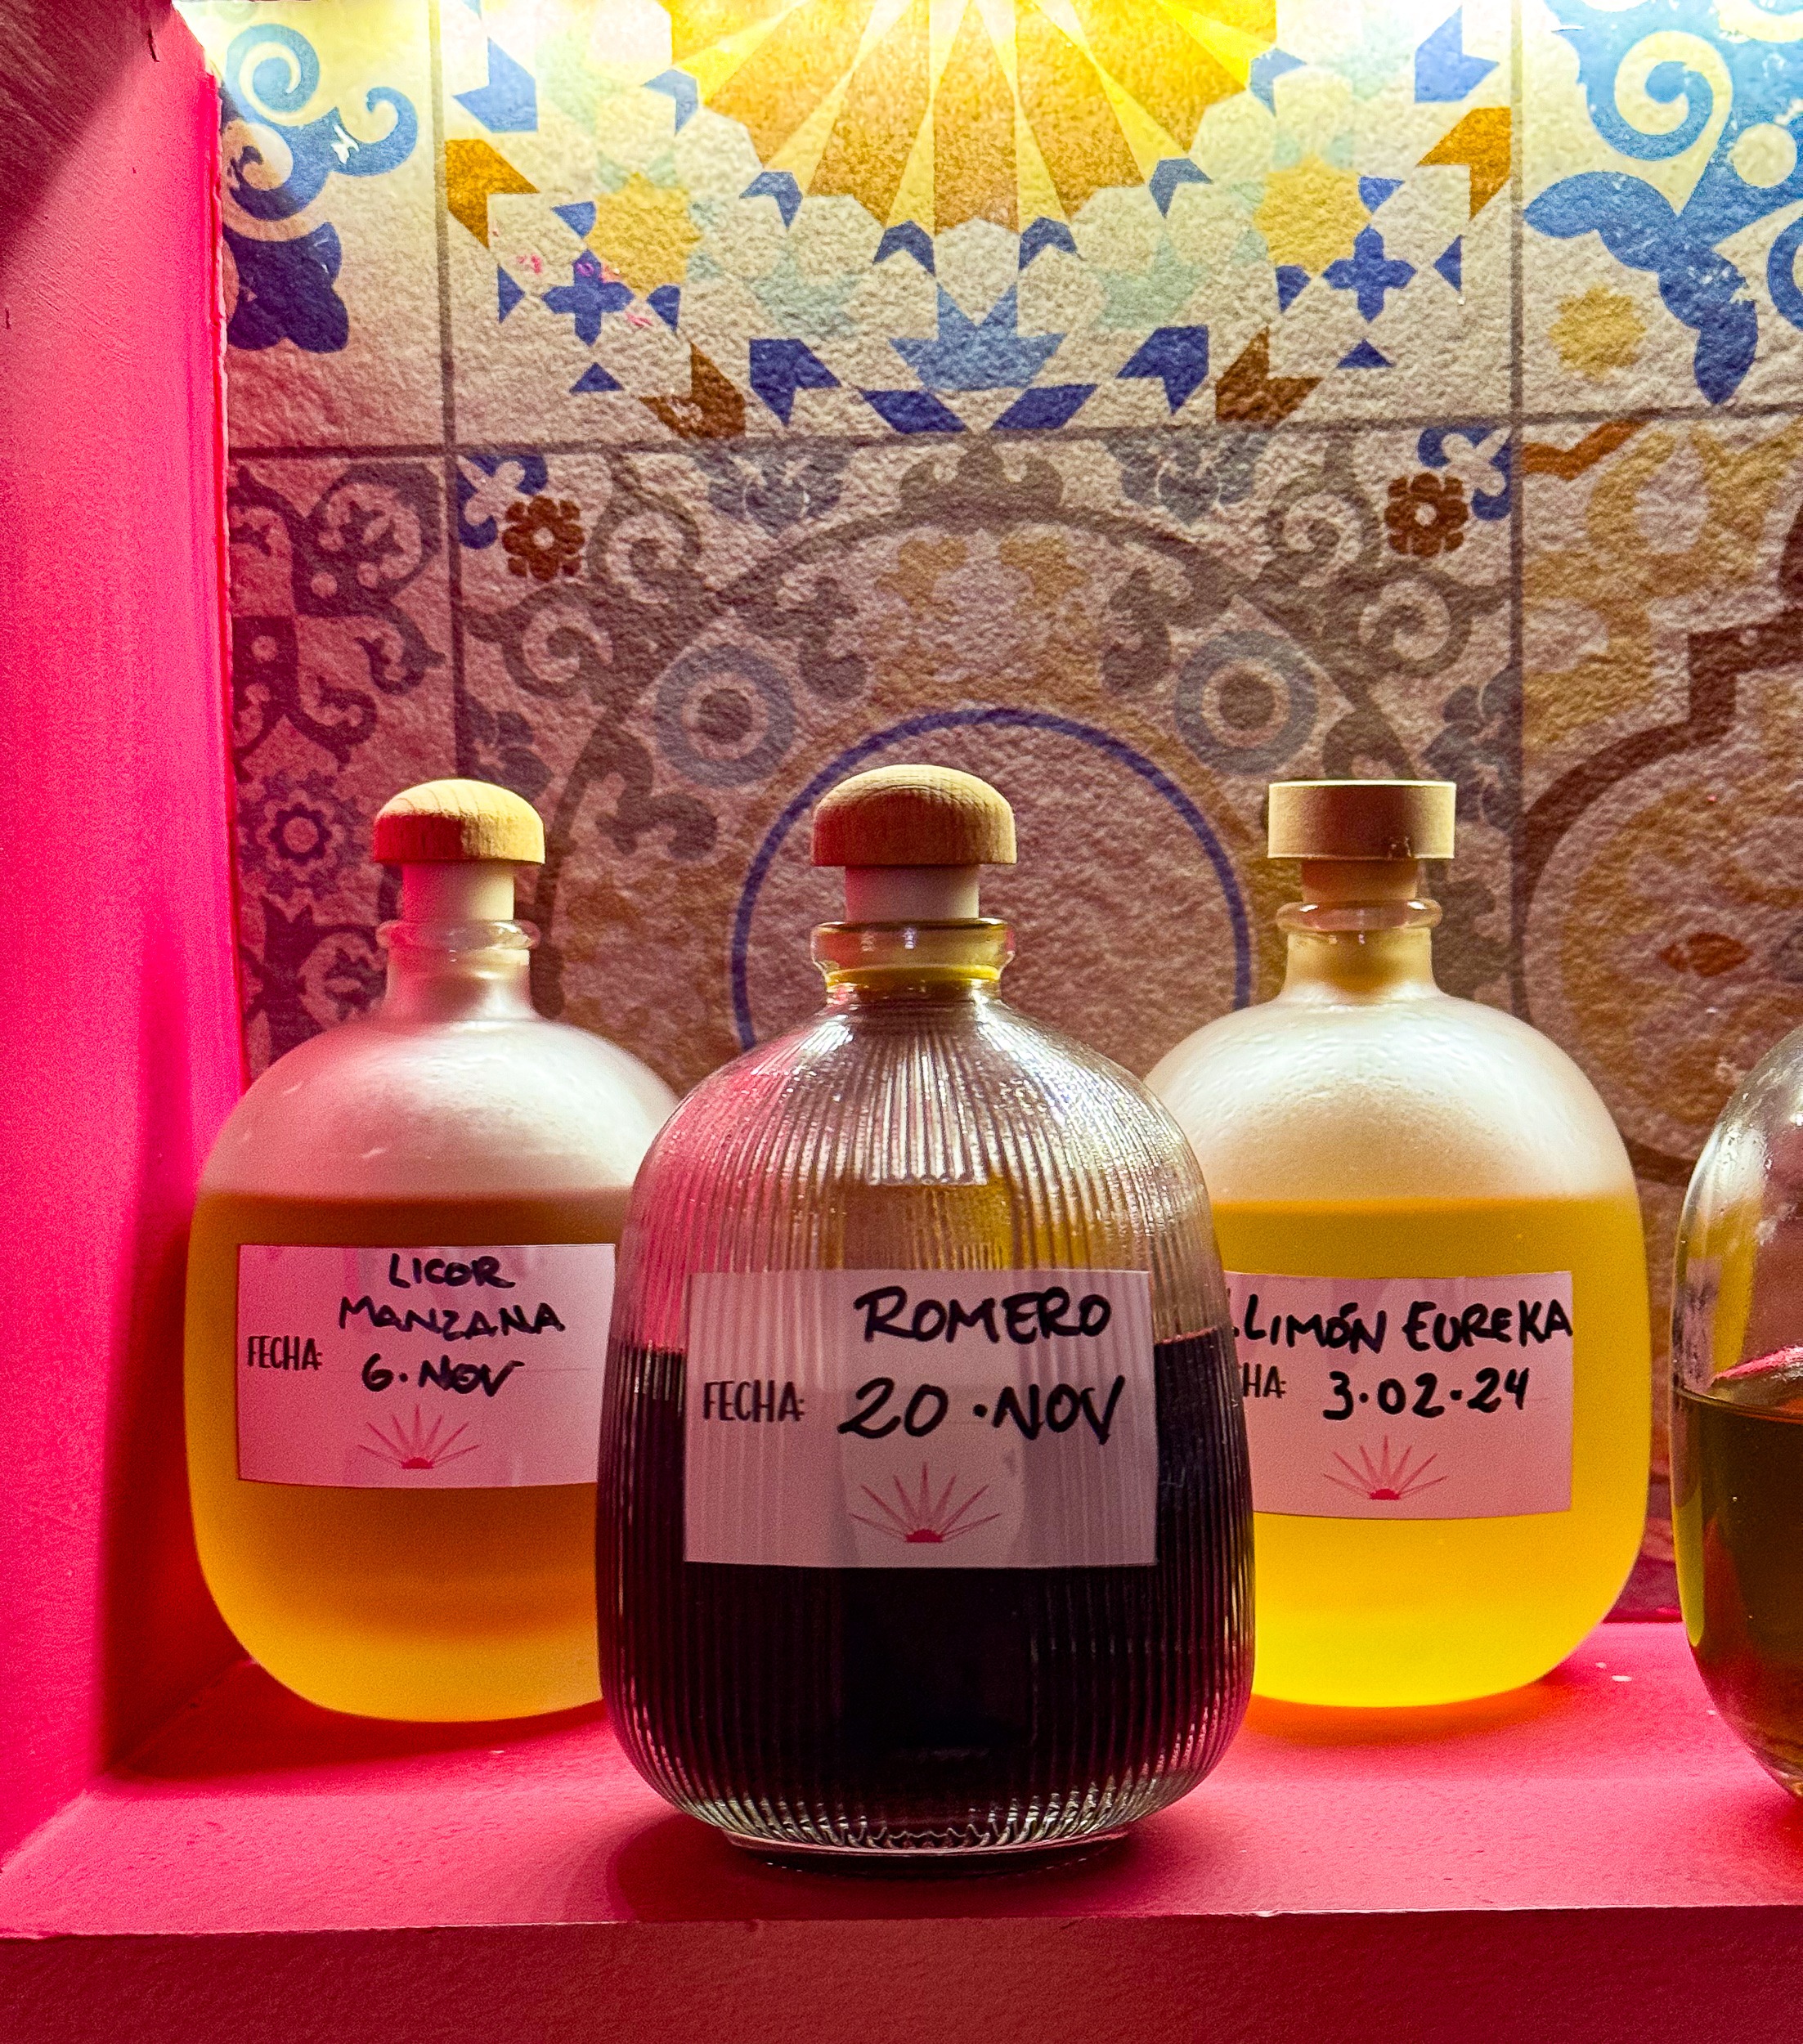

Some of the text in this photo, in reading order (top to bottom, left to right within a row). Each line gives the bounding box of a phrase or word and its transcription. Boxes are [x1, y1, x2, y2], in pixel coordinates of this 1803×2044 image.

[389, 1253, 516, 1289] LICOR
[339, 1295, 566, 1342] MANZANA
[853, 1285, 1111, 1345] ROMERO
[1402, 1299, 1572, 1353] EUREKA
[247, 1335, 323, 1371] FECHA:
[702, 1380, 805, 1423] FECHA:
[836, 1377, 949, 1440] 20
